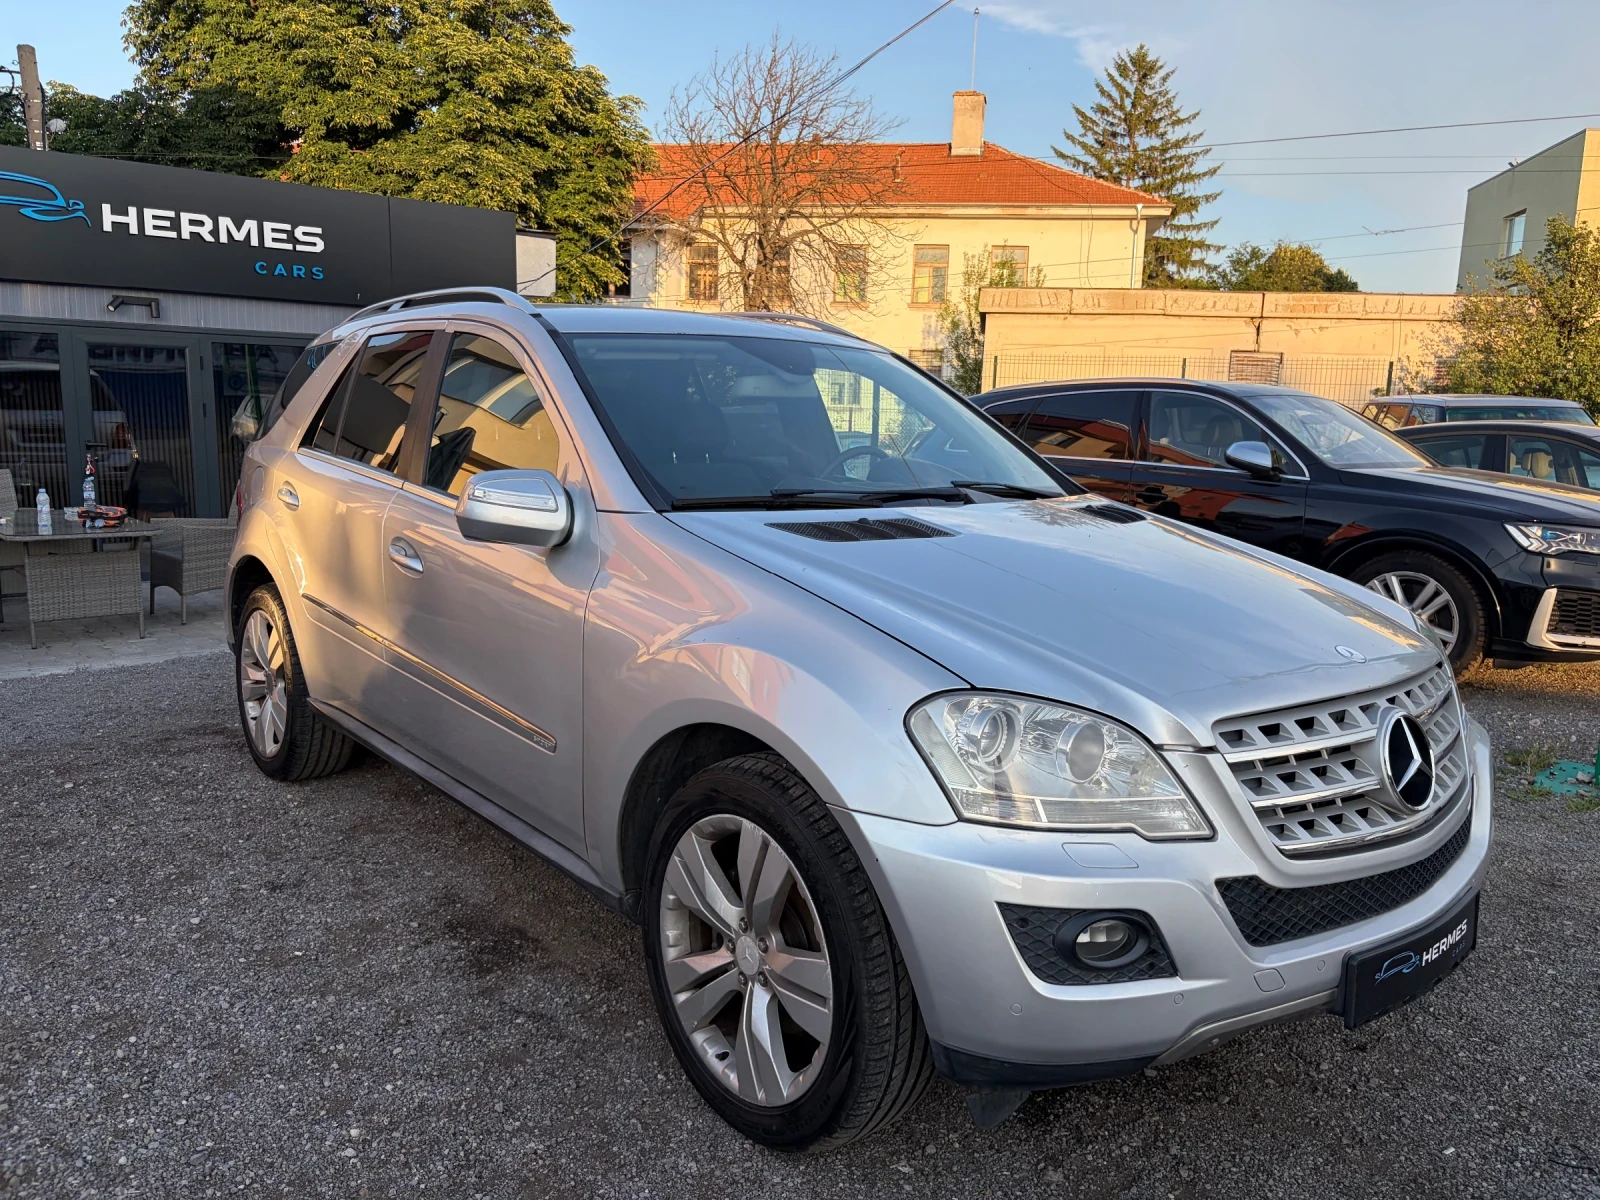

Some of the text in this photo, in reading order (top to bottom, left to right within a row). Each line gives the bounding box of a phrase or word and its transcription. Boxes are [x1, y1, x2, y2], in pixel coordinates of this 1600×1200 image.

[101, 203, 325, 253] HERMES
[254, 261, 324, 280] CARS
[1421, 918, 1468, 967] HERMES
[1451, 940, 1466, 957] CARS
